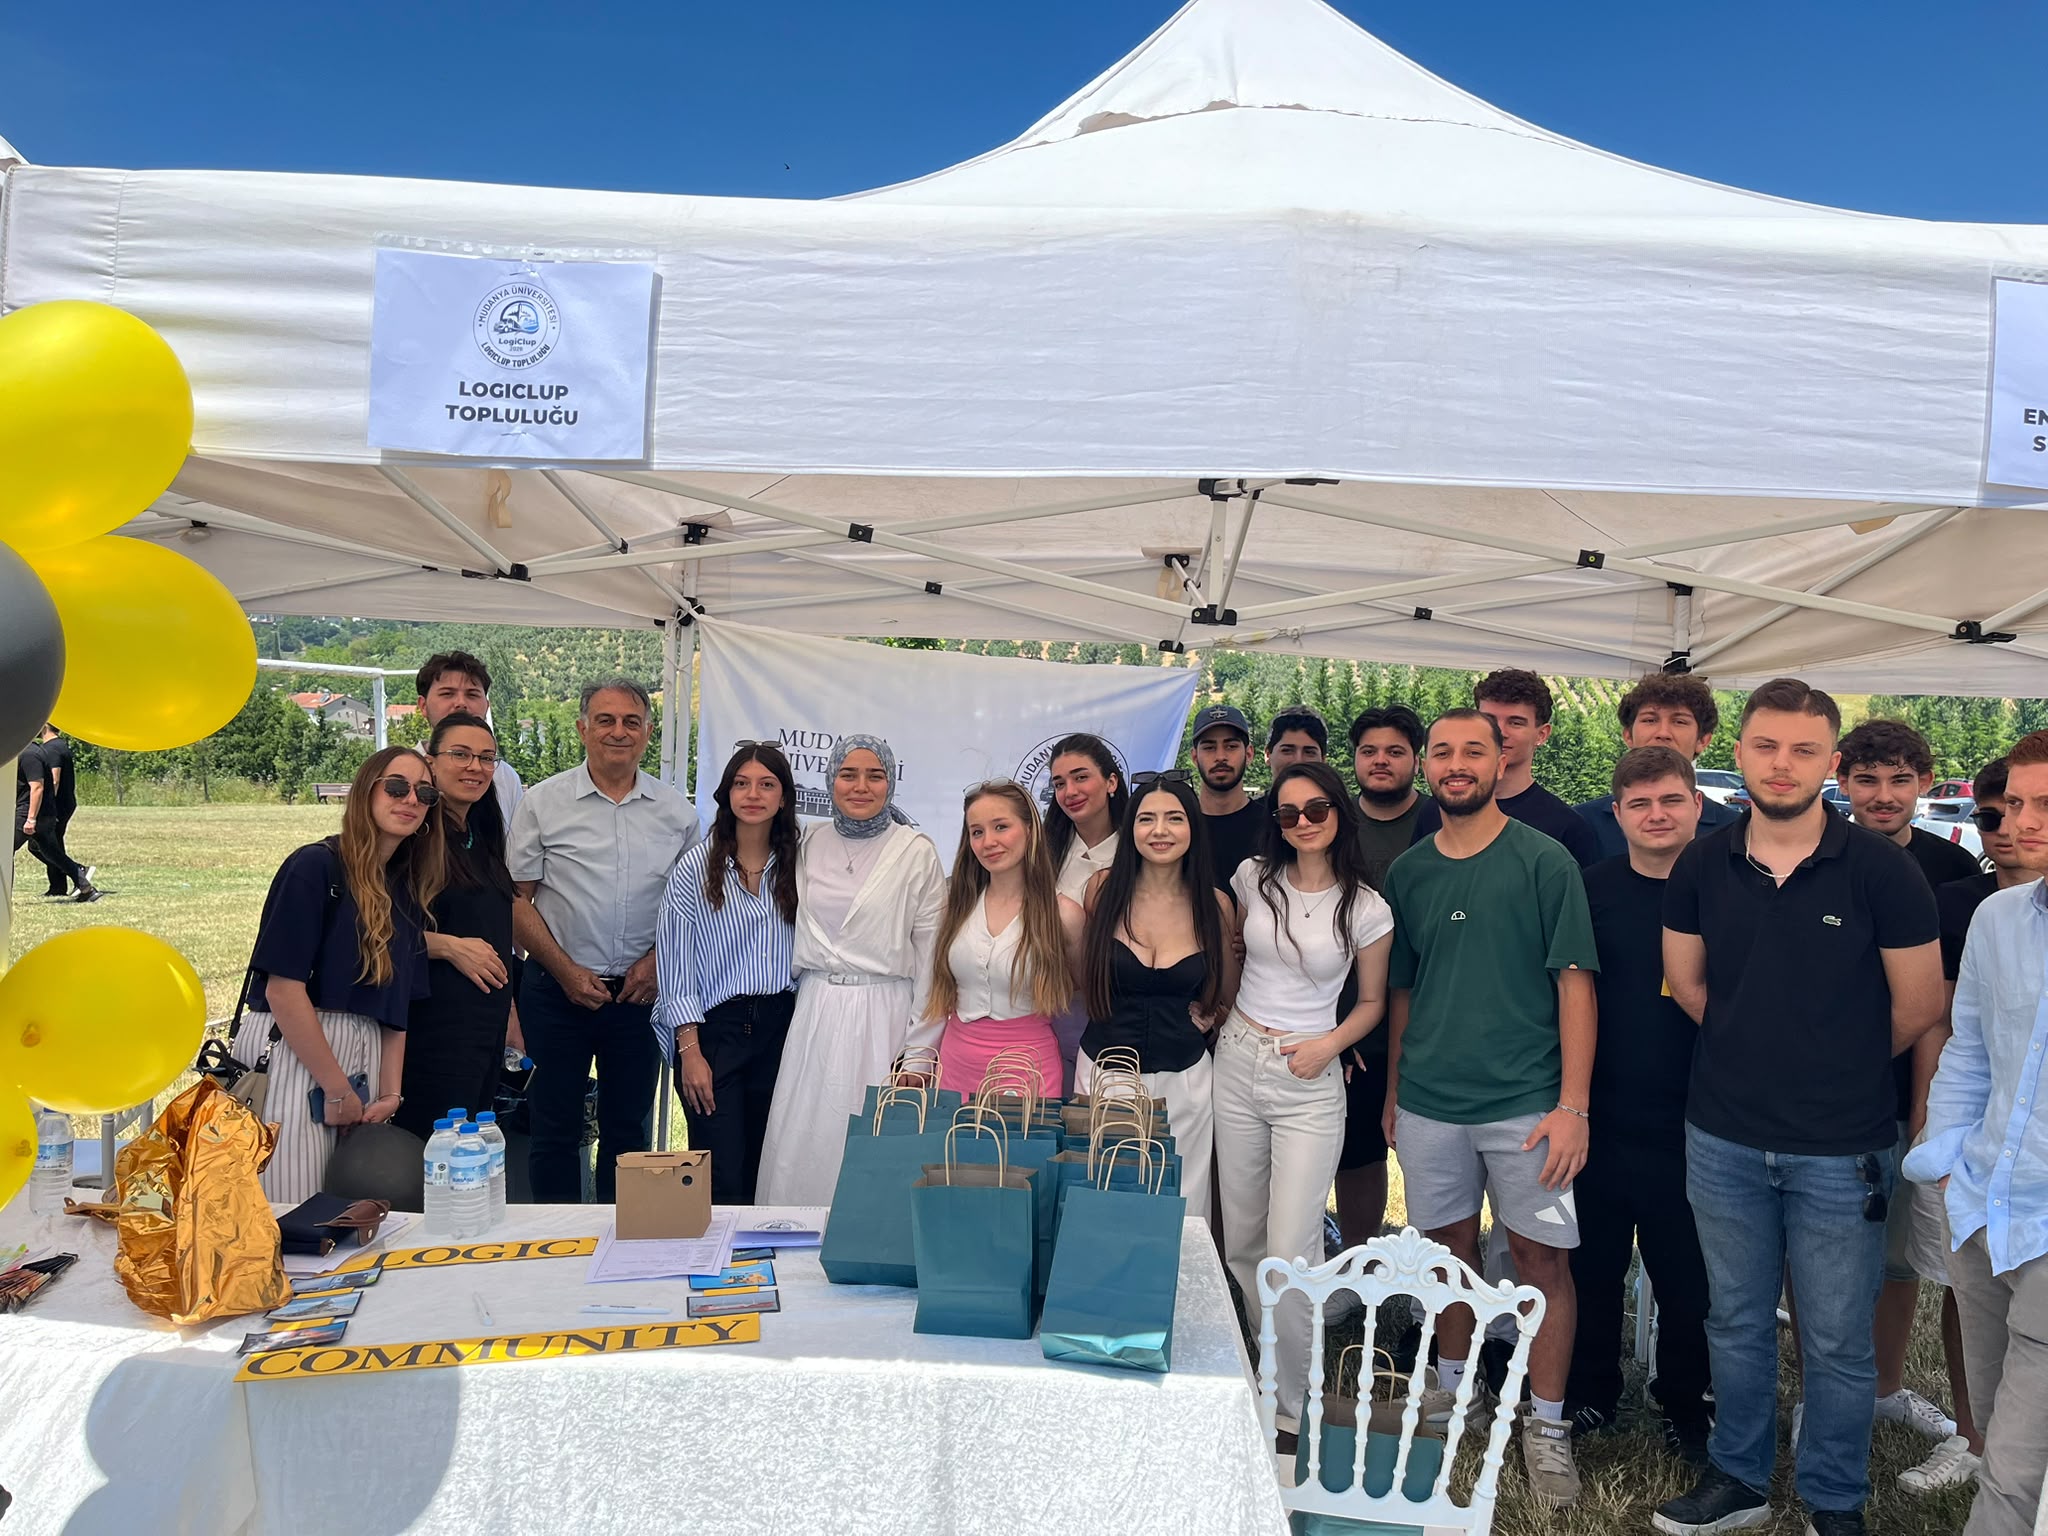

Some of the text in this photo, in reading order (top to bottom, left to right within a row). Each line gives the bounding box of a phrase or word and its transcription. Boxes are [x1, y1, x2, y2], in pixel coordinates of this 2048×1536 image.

[479, 285, 557, 324] MUDANYA ÜNİVERSİTESİ
[481, 341, 551, 368] LOGICLUP TOPLULUĞU
[498, 338, 537, 347] LogiClup
[459, 381, 569, 401] LOGICLUP
[445, 404, 579, 426] TOPLULUĞU
[1019, 743, 1055, 789] MUDANY
[369, 1238, 598, 1269] LOGIC
[246, 1318, 749, 1375] COMMUNITY
